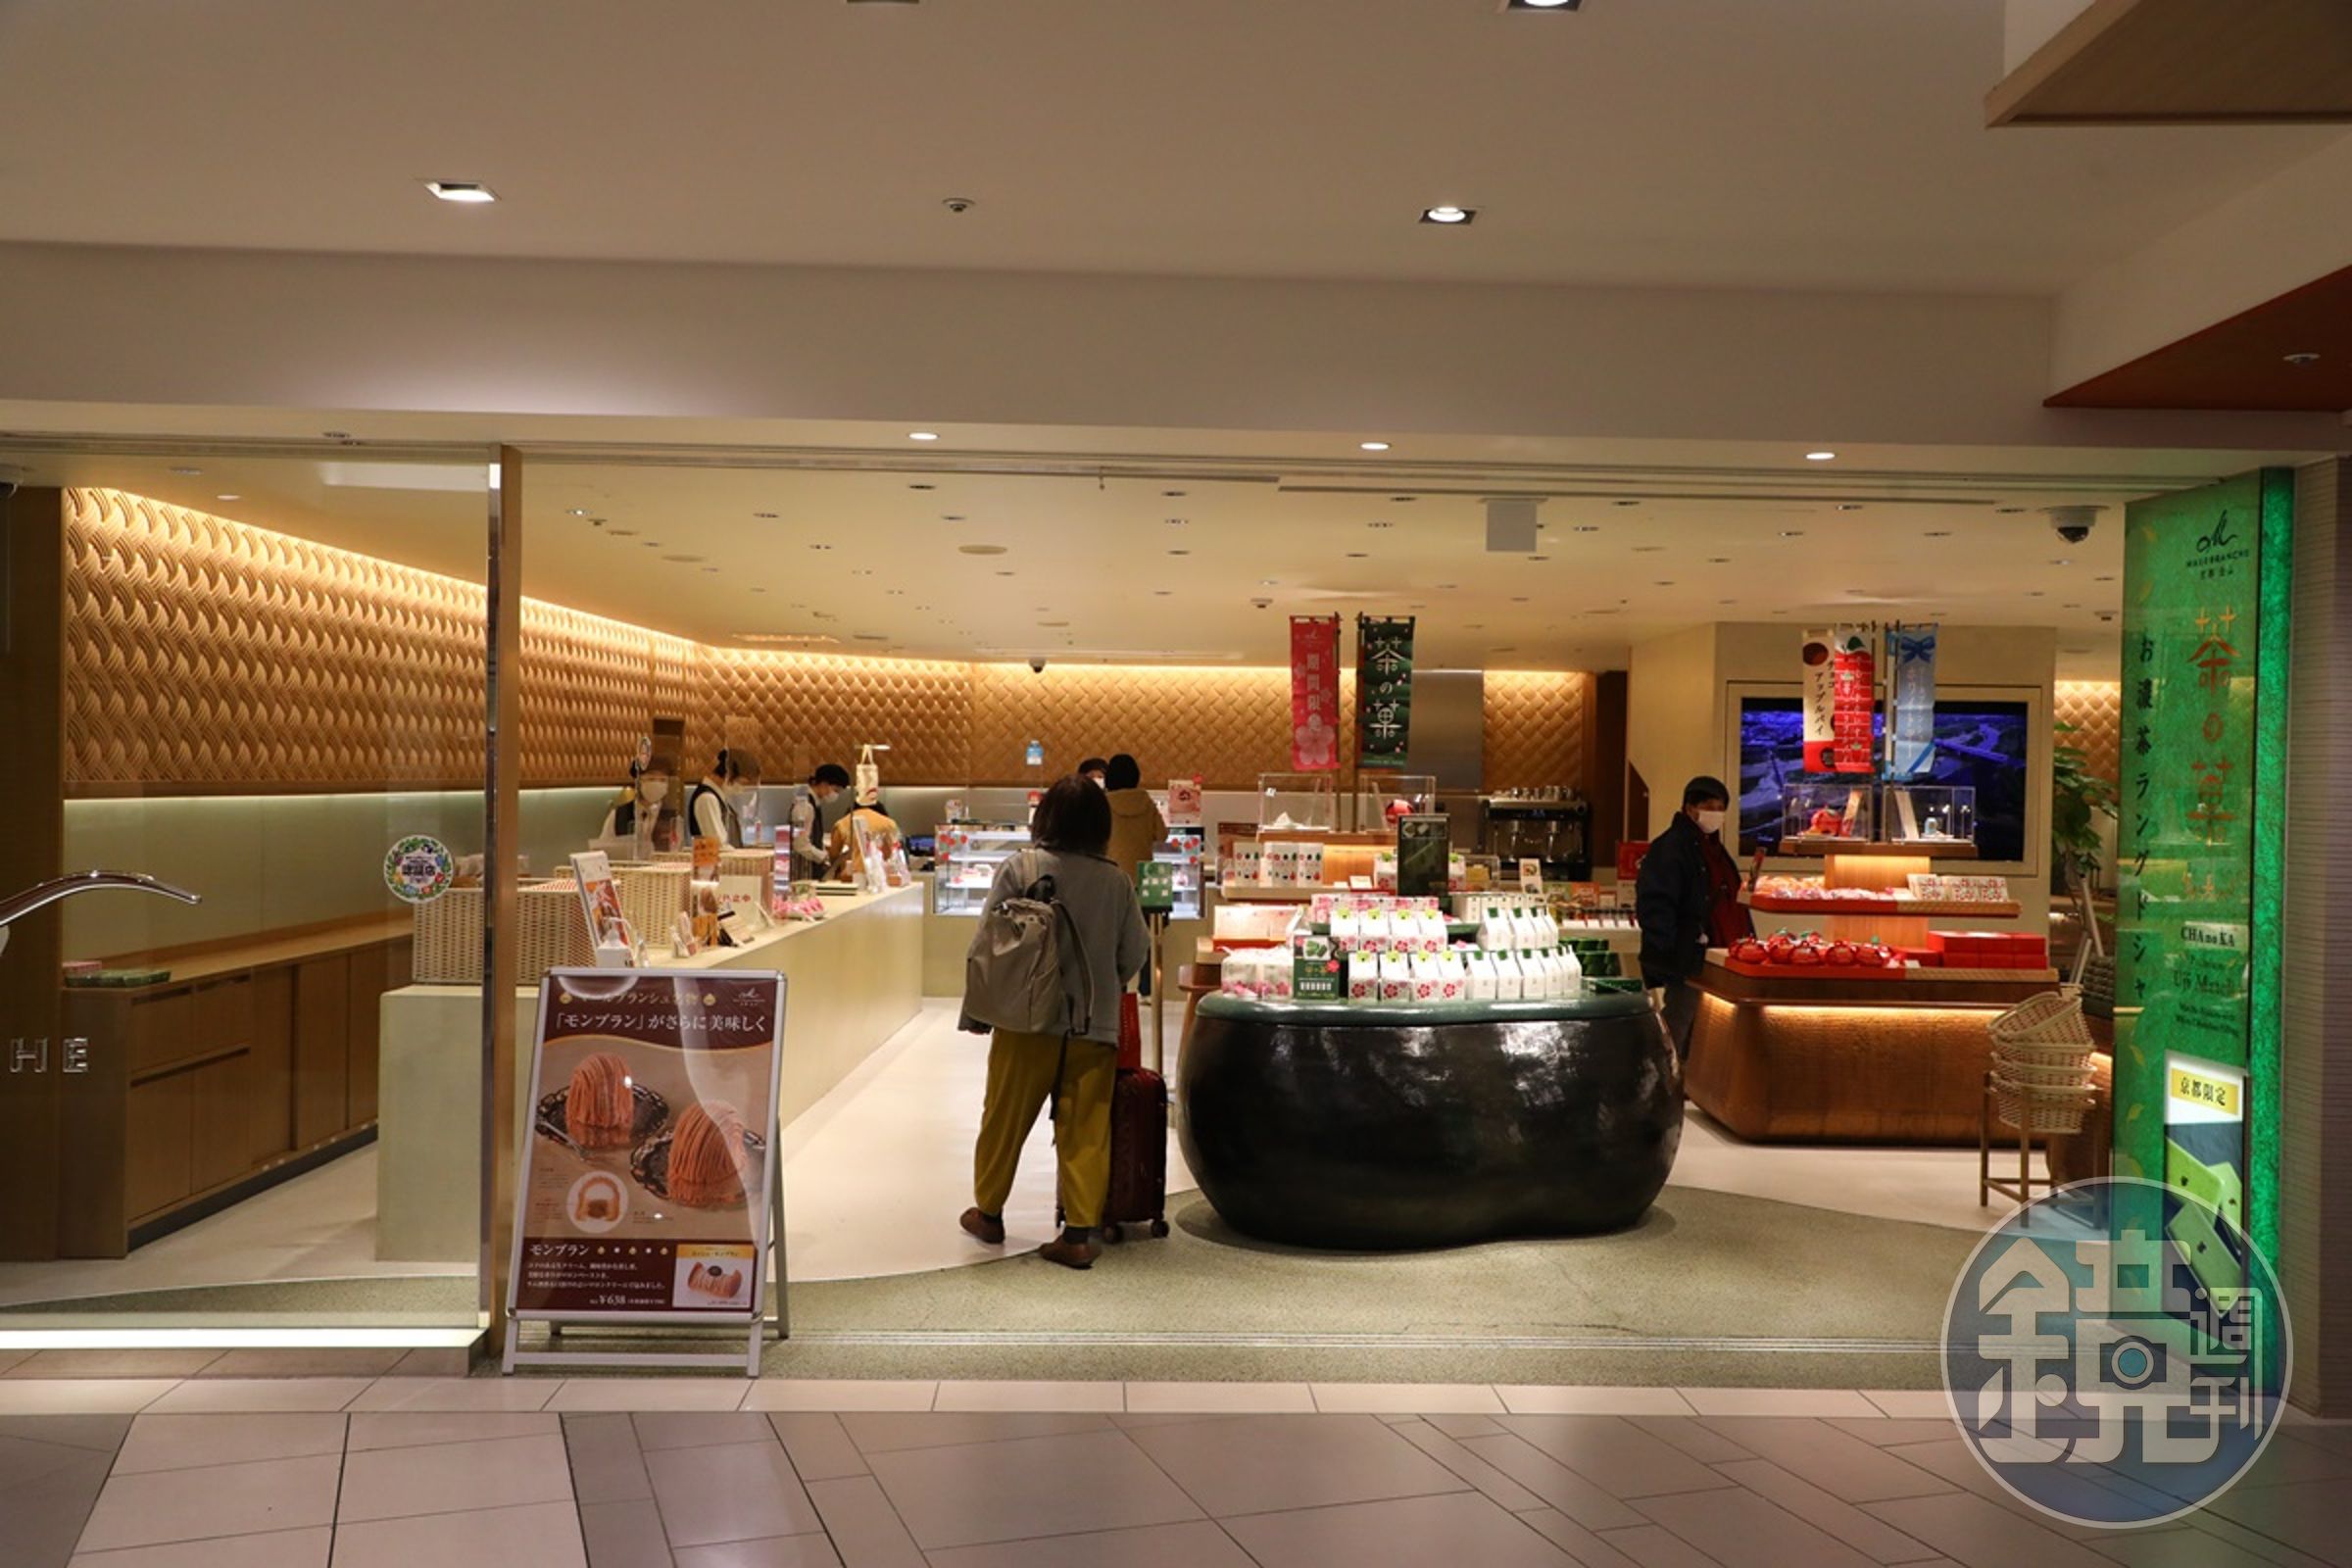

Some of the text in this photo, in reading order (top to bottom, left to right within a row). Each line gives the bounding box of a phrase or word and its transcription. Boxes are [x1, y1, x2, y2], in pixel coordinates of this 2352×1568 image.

[1369, 637, 1405, 740] 茶の菓
[1814, 671, 1827, 736] アップルパイ
[2179, 1076, 2226, 1106] 京都限定
[530, 1244, 589, 1256] モンブラン
